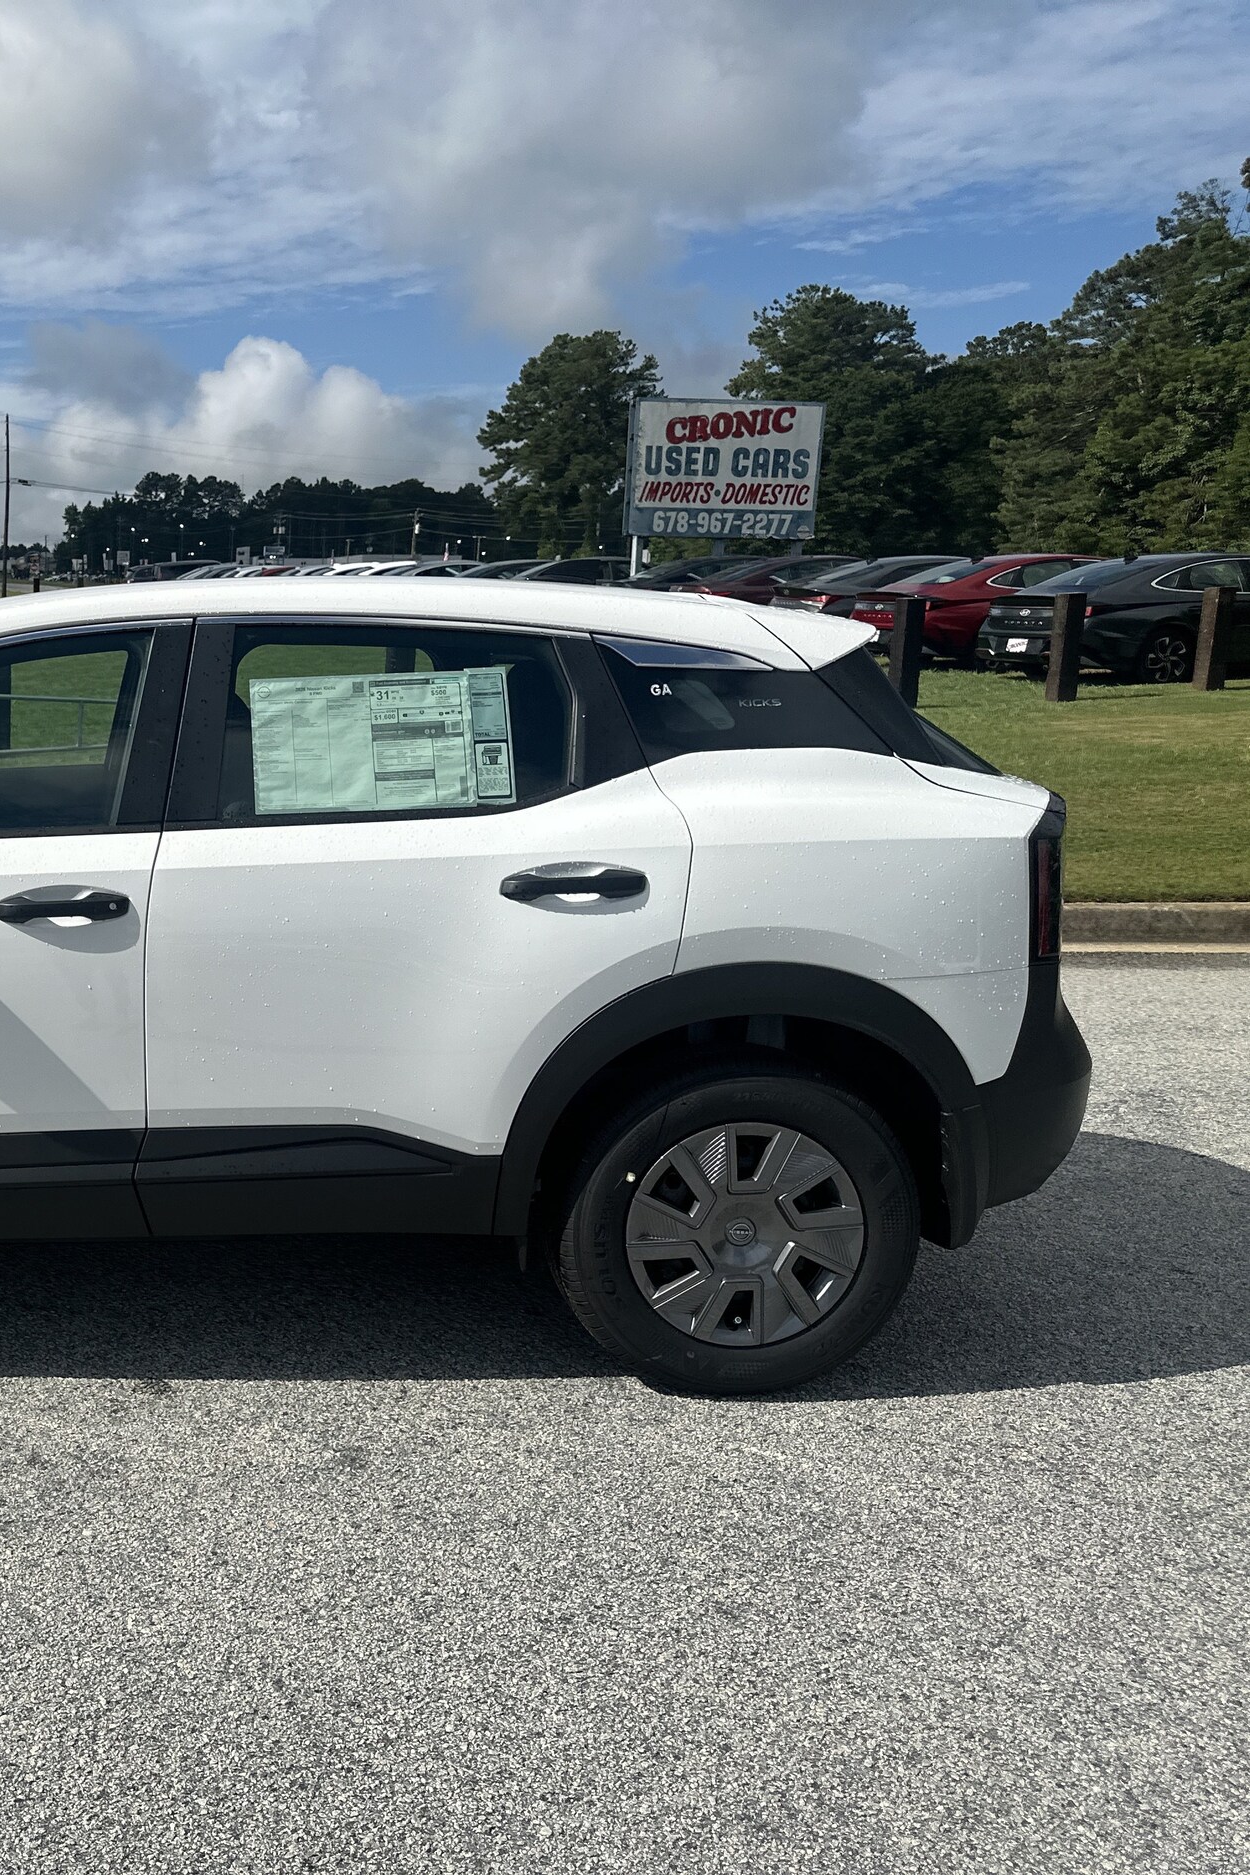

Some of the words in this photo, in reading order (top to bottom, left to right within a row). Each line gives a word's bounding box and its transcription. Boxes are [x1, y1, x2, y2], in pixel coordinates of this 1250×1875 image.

[665, 406, 797, 445] CRONIC
[644, 445, 721, 477] USED
[730, 447, 811, 479] CARS
[638, 481, 714, 504] IMPORTS
[720, 482, 811, 506] DOMESTIC
[652, 511, 793, 536] 678-967-2277
[376, 690, 389, 701] 31
[650, 683, 672, 696] GA
[738, 698, 782, 708] KICKS
